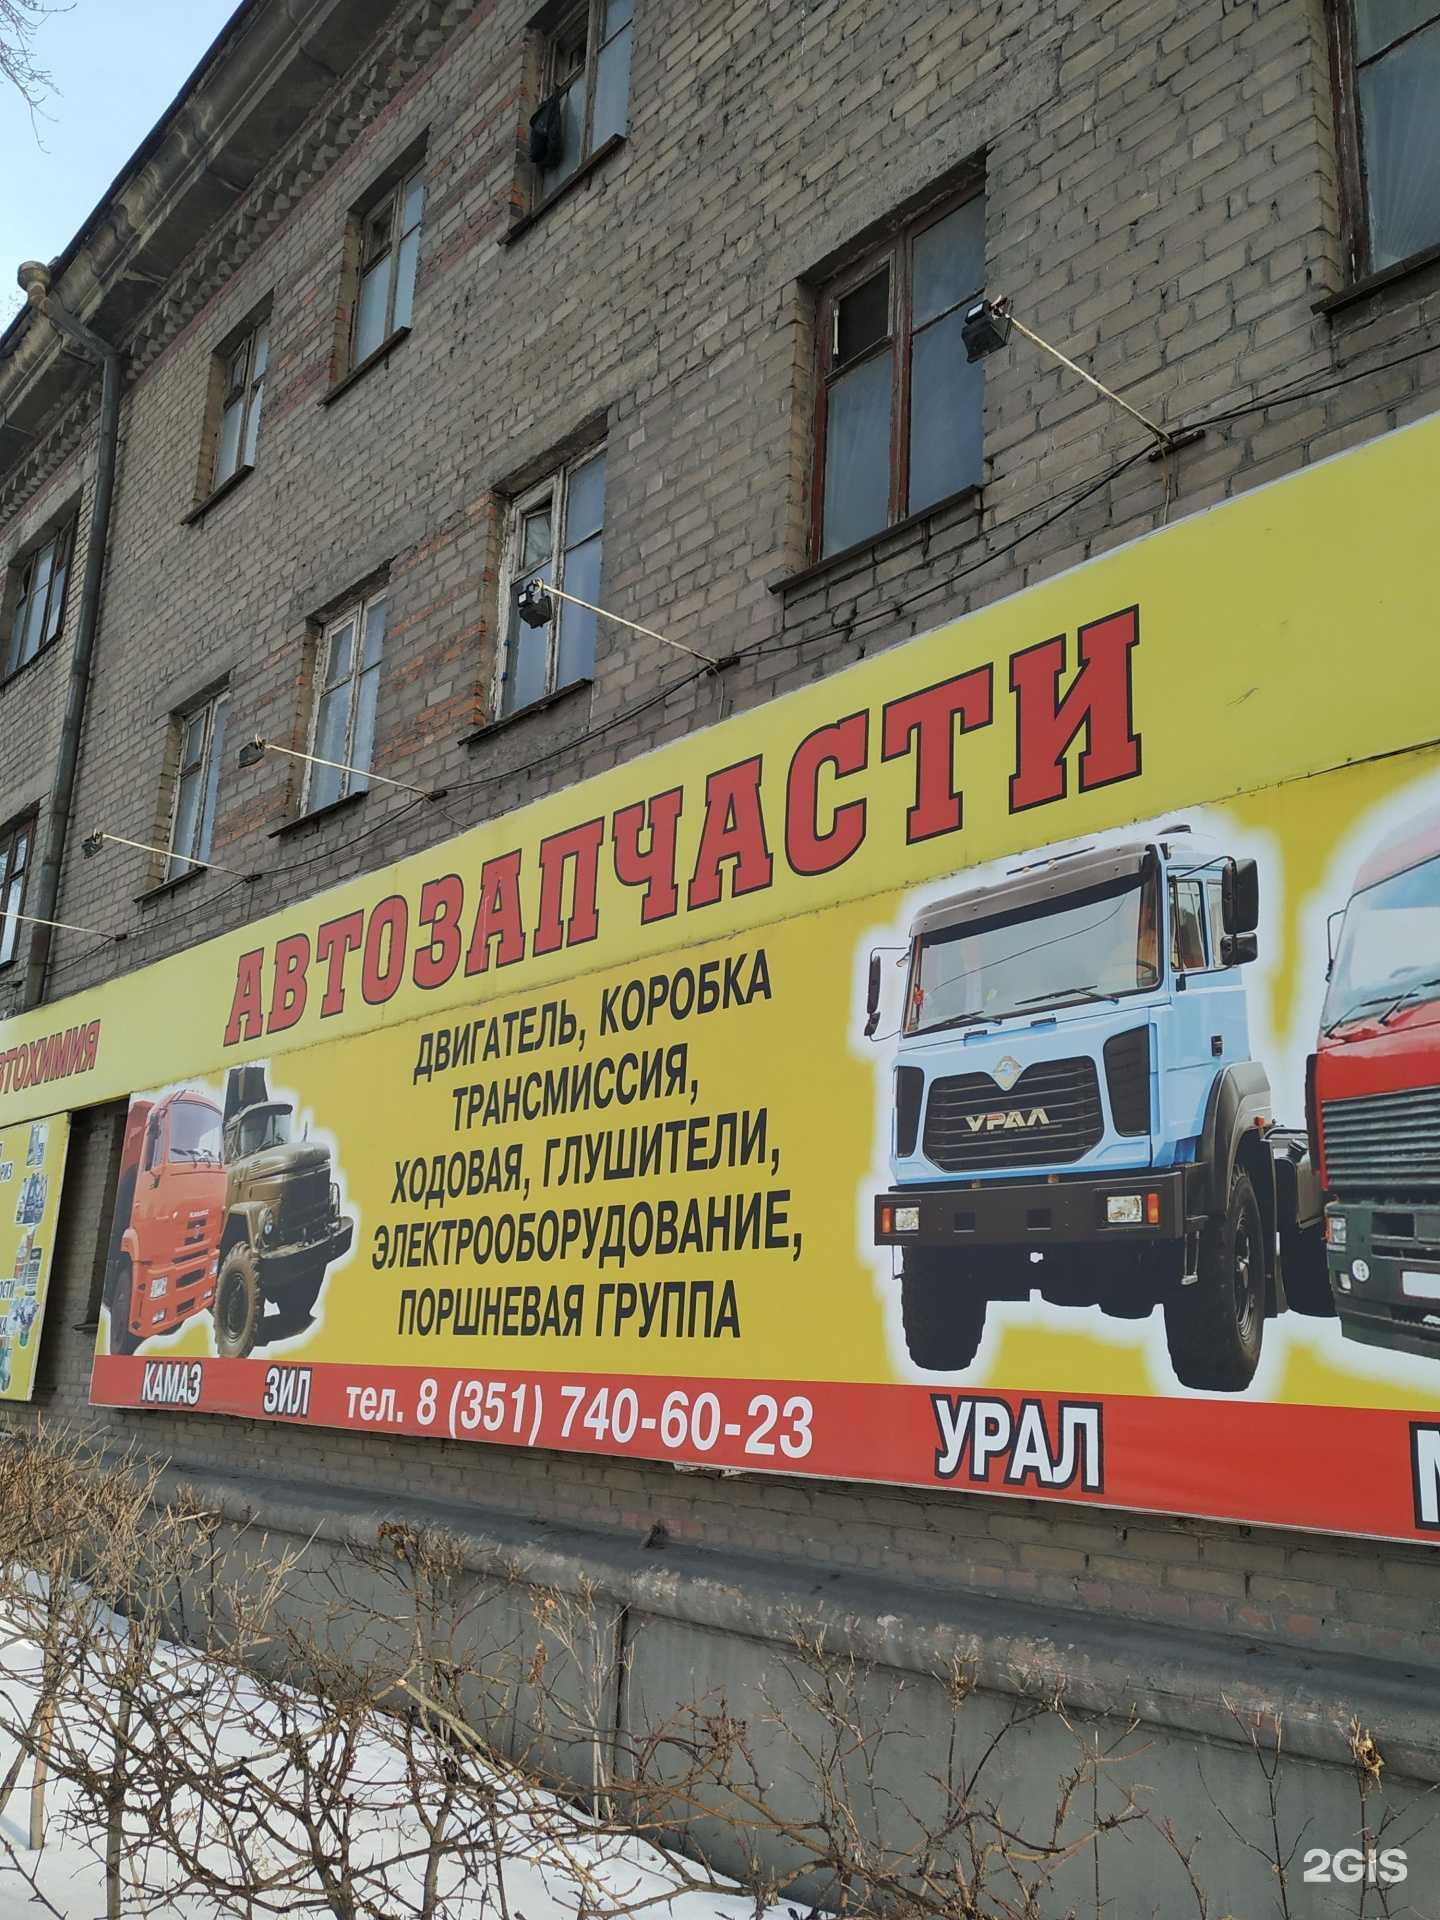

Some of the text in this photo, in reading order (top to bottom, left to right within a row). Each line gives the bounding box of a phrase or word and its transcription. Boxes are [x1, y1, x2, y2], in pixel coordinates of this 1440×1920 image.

[223, 603, 1142, 1046] АВТОЗАПЧАСТИ
[413, 949, 772, 1085] ДВИГАТЕЛЬ, КОРОБКА
[452, 1043, 699, 1131] ТРАНСМИССИЯ,
[391, 1108, 781, 1210] ХОДОВАЯ, ГЛУШИТЕЛИ,
[372, 1190, 803, 1270] ЭЛЕКТРООБОРУДОВАНИЕ,
[398, 1279, 741, 1339] ПОРШНЕВАЯ ГРУППА
[141, 1360, 203, 1407] КАМАЗ
[263, 1364, 313, 1418] ЗИЛ
[346, 1378, 814, 1459] тел. 8 (351) 740-60-23
[930, 1393, 1104, 1494] УРАЛ
